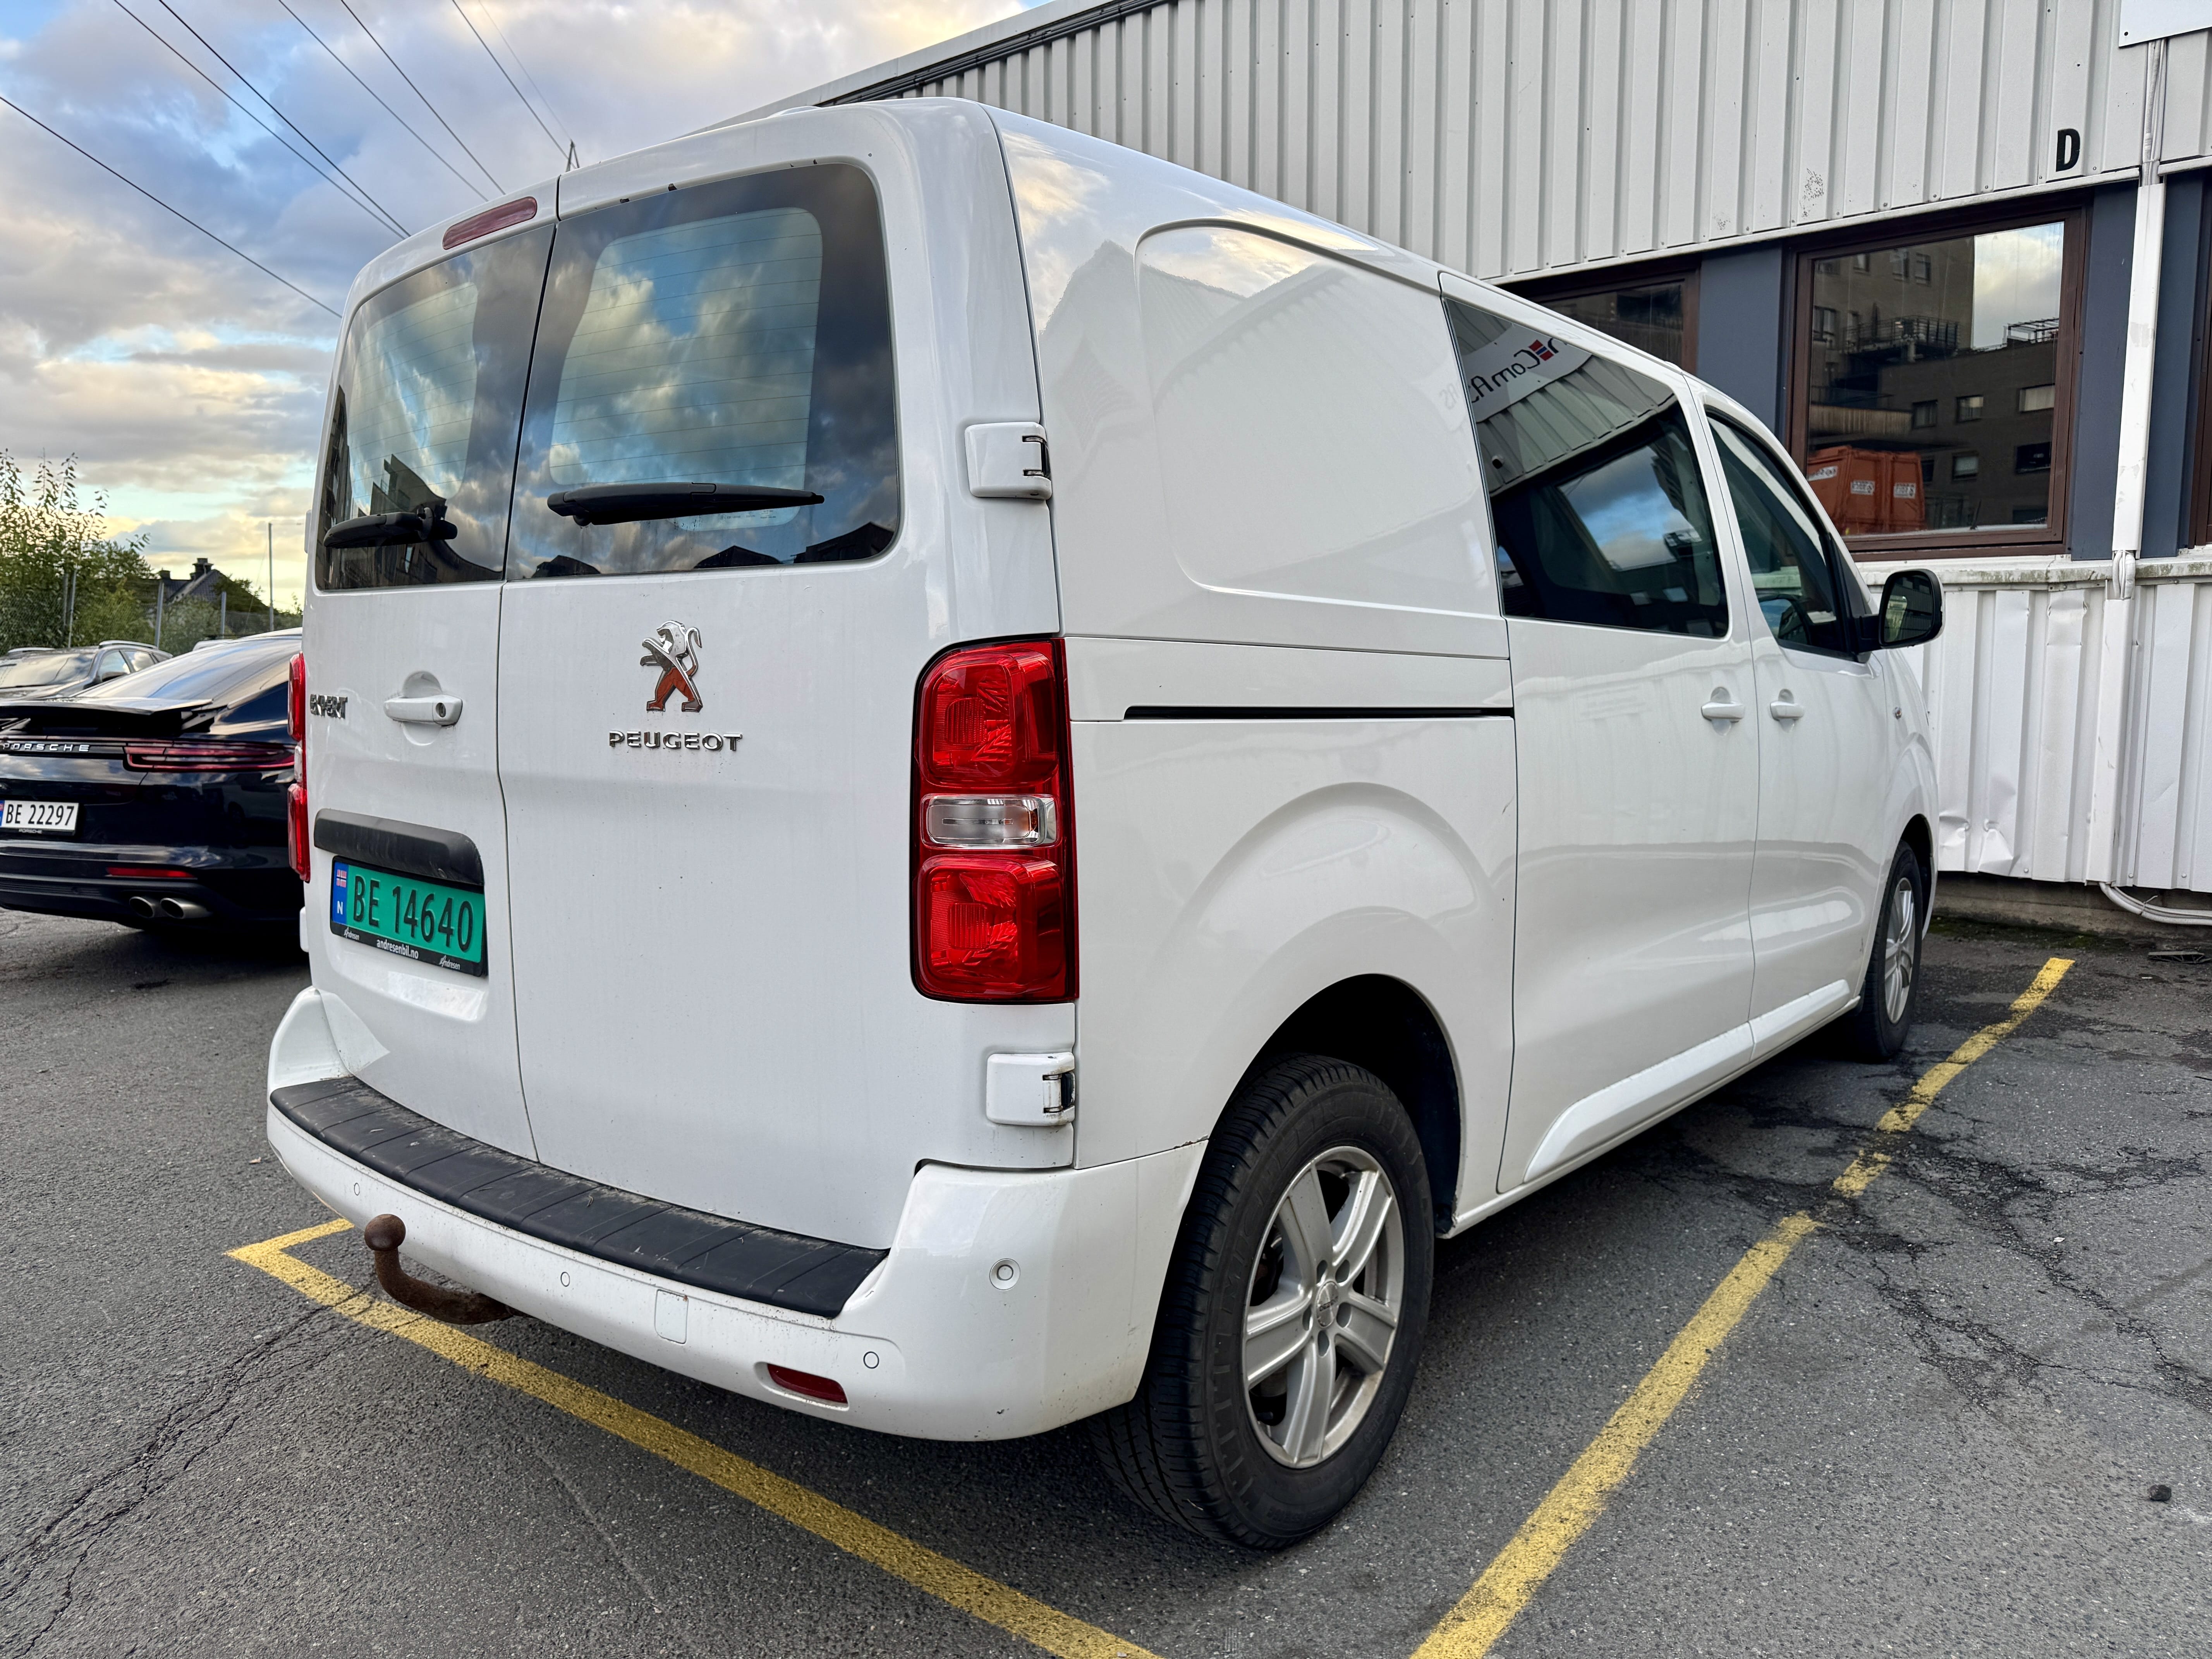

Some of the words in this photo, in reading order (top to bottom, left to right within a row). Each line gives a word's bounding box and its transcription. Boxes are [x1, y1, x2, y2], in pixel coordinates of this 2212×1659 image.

[2056, 128, 2081, 172] D
[310, 694, 348, 719] EXPERT
[3, 743, 90, 752] PORSCHE
[609, 731, 743, 751] PEUGEOT
[6, 804, 22, 824] BE
[28, 804, 75, 826] 22297
[337, 901, 343, 915] N
[353, 875, 380, 927] BE
[392, 886, 473, 952] 14640
[377, 939, 419, 959] andresenbil.no
